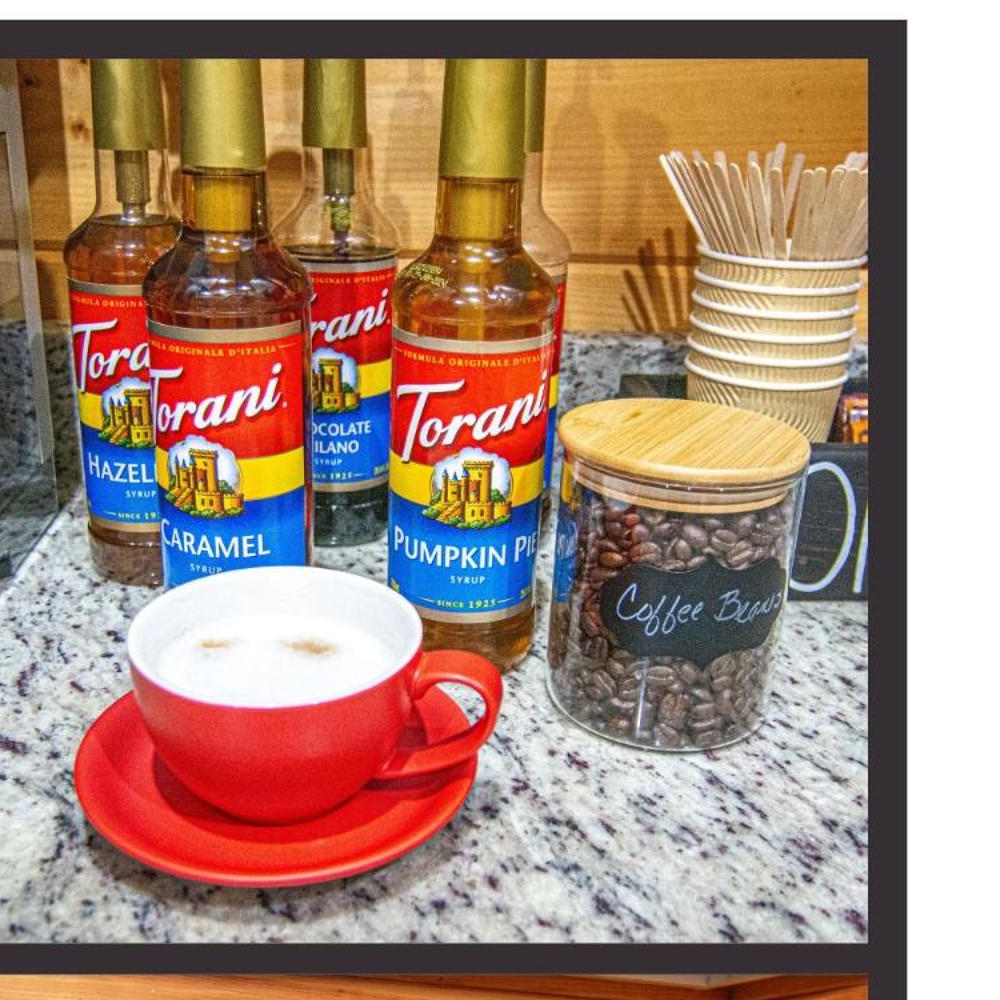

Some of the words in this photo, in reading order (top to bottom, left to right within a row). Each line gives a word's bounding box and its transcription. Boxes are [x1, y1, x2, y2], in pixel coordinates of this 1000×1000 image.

[150, 362, 284, 442] Torani
[397, 368, 547, 463] Torani
[88, 451, 158, 484] HAZEL
[125, 489, 157, 499] SYRUP
[160, 517, 272, 559] CARAMEL
[394, 524, 507, 569] PUMPKIN
[449, 575, 487, 585] SYRUP
[436, 599, 464, 609] SINCE
[468, 599, 497, 609] 1925
[615, 582, 705, 637] Coffee
[713, 588, 782, 624] Beans
